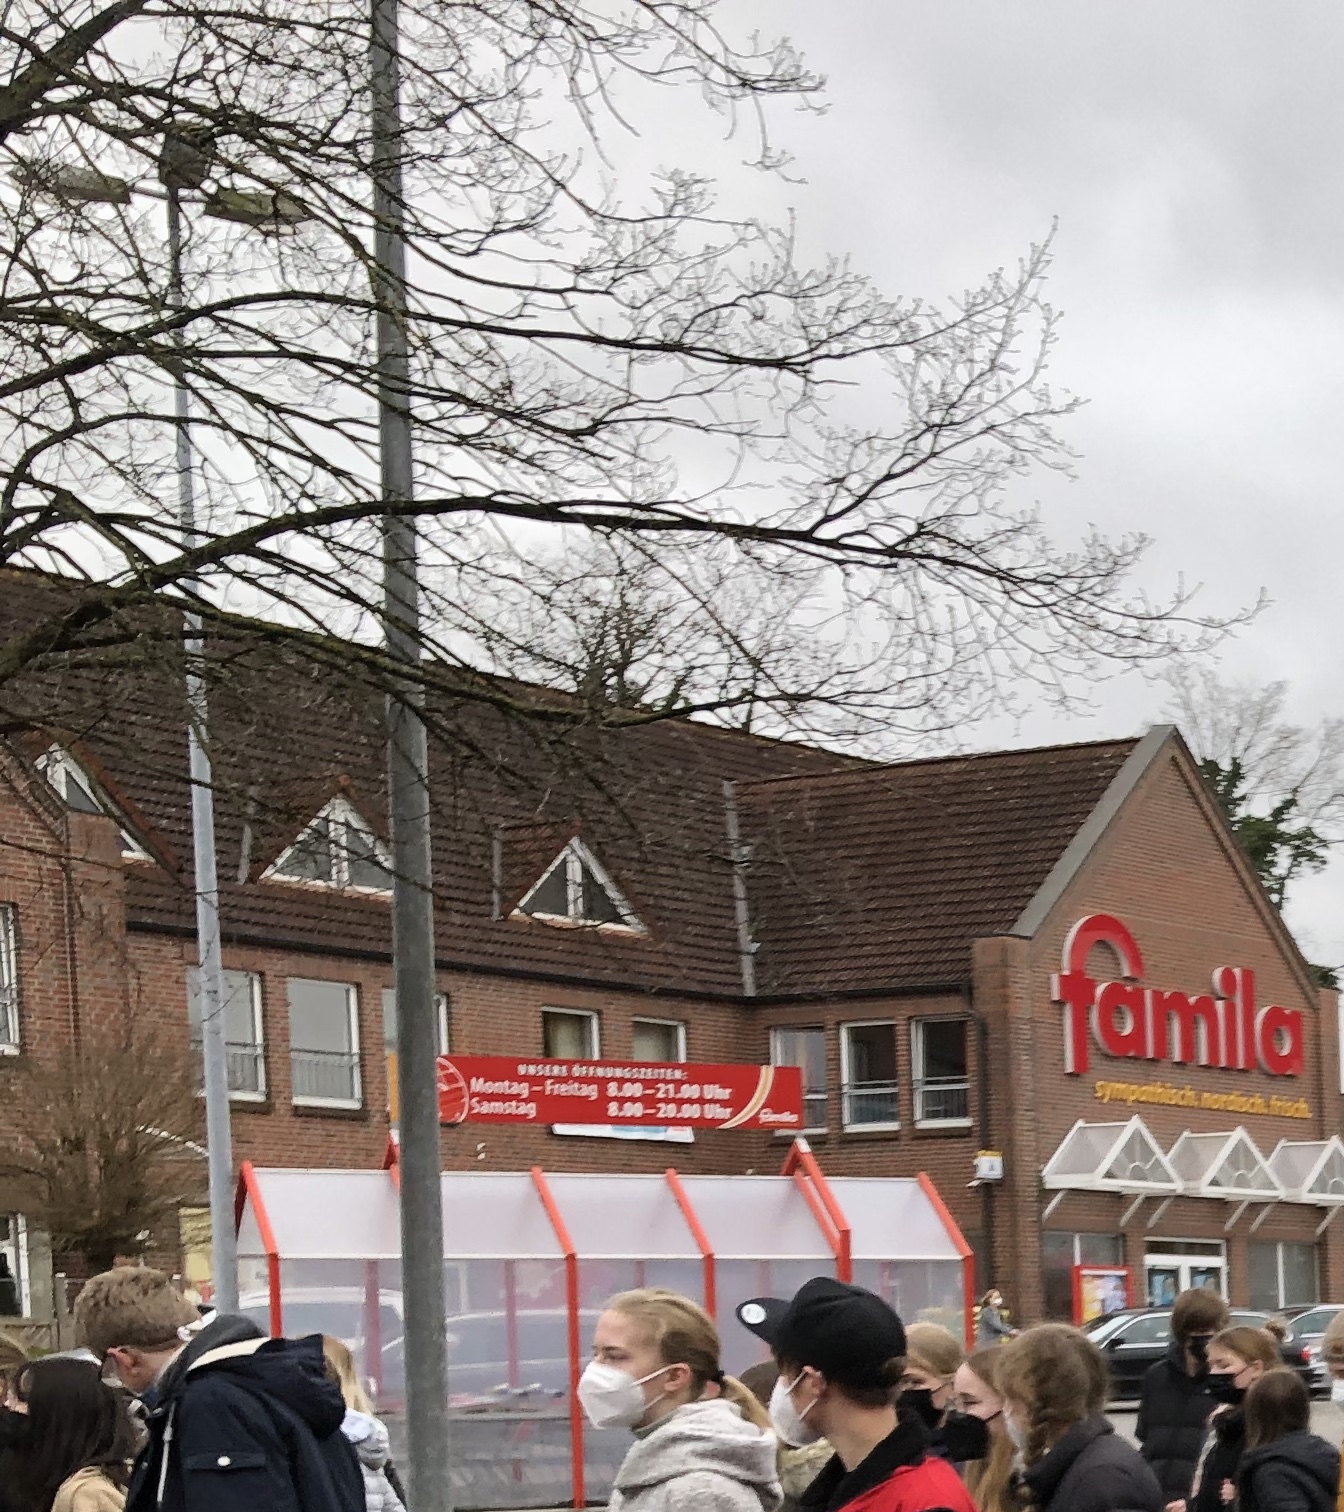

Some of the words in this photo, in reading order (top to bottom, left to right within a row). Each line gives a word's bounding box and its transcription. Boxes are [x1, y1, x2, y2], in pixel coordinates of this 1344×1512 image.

[1051, 914, 1304, 1075] famila
[517, 1064, 568, 1076] UNSERE
[470, 1077, 529, 1098] Montag
[545, 1079, 598, 1100] Freitag
[703, 1084, 732, 1100] Uhr
[470, 1097, 537, 1119] Samstag
[703, 1103, 732, 1119] Uhr
